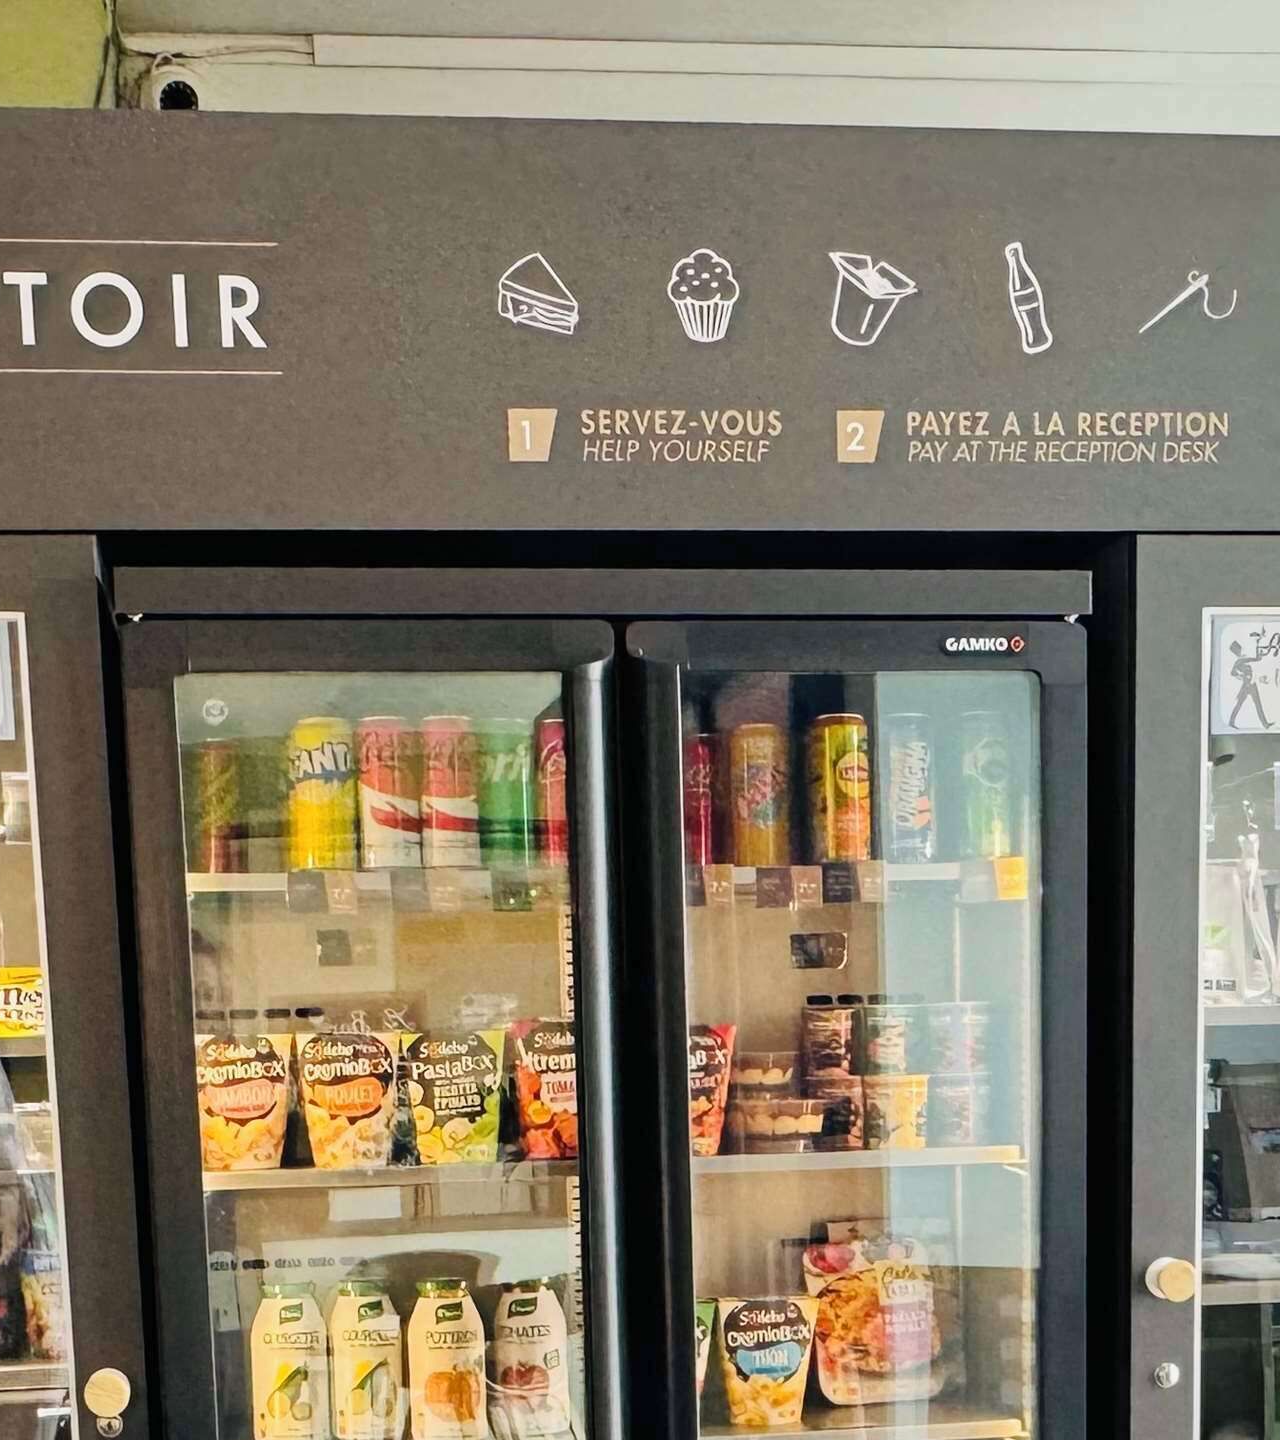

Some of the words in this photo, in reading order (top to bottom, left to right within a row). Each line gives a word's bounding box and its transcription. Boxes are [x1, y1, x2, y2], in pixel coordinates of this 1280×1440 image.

[519, 420, 534, 451] 1
[580, 409, 784, 437] SERVEZ-VOUS
[845, 421, 867, 452] 2
[906, 410, 990, 437] PAYEZ
[1002, 411, 1021, 437] A
[1032, 411, 1066, 437] LA
[1076, 411, 1231, 438] RECEPTION
[582, 440, 642, 463] HELP
[647, 440, 772, 463] YOURSELF
[907, 441, 953, 464] PAY
[956, 441, 985, 464] AT
[986, 441, 1028, 464] THE
[1034, 441, 1158, 464] RECEPTION
[1164, 441, 1220, 464] DESK
[945, 637, 1008, 652] GAMKO
